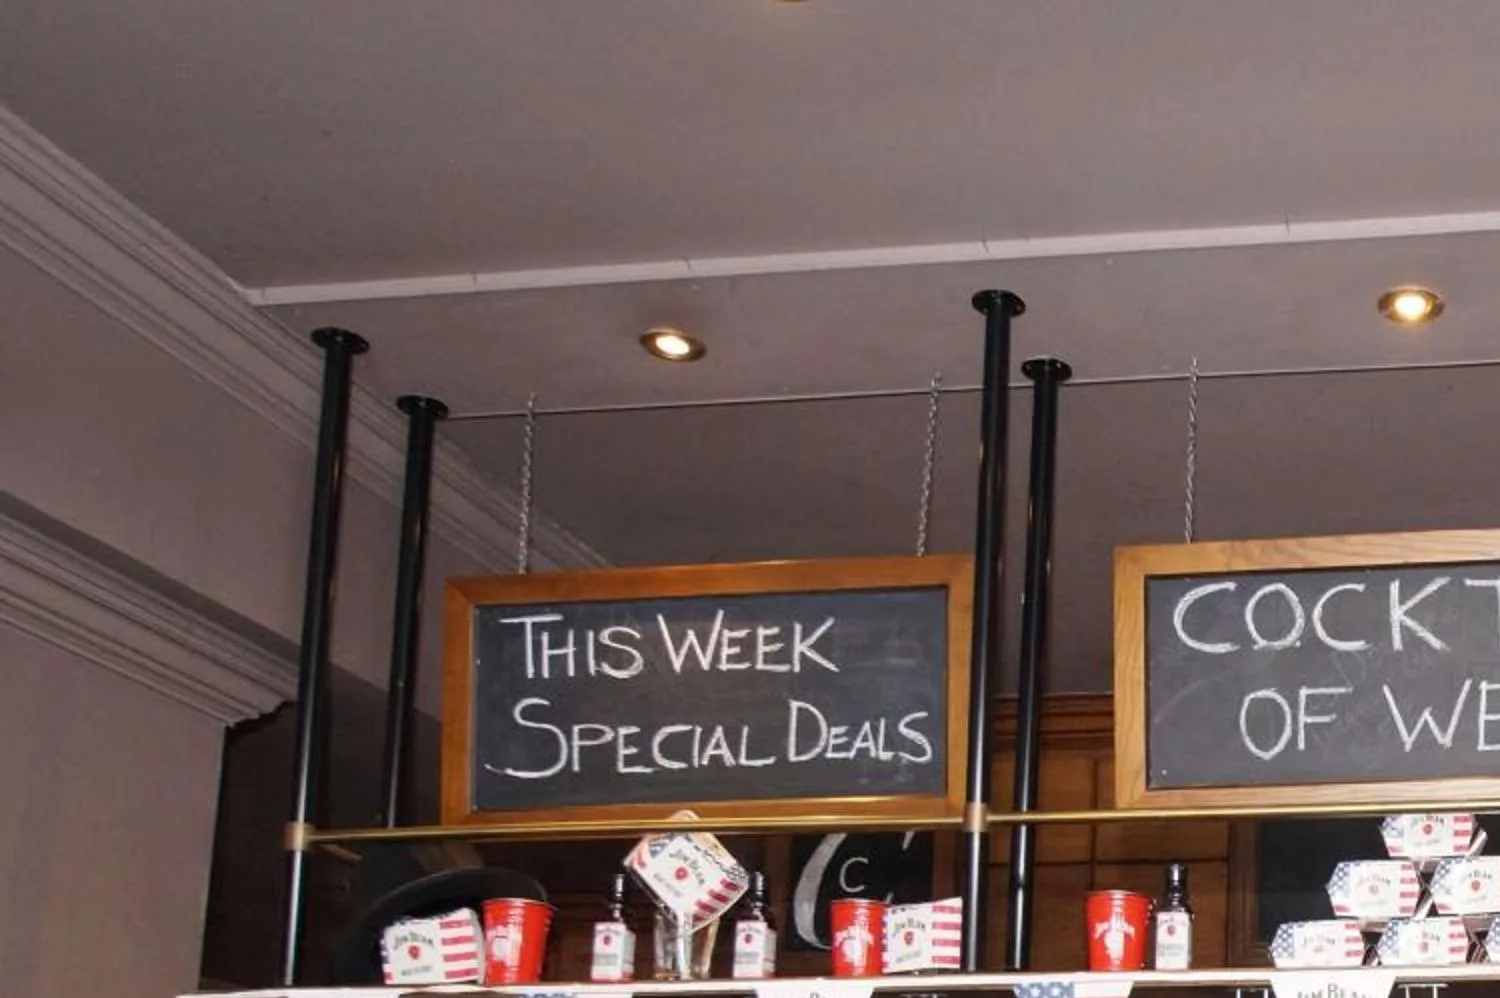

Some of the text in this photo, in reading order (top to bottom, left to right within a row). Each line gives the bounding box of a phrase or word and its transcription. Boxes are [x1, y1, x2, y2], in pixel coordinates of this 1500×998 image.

[499, 609, 840, 679] THIS WEEK
[484, 697, 933, 779] SPECIAL DEALS
[1240, 687, 1353, 760] OF
